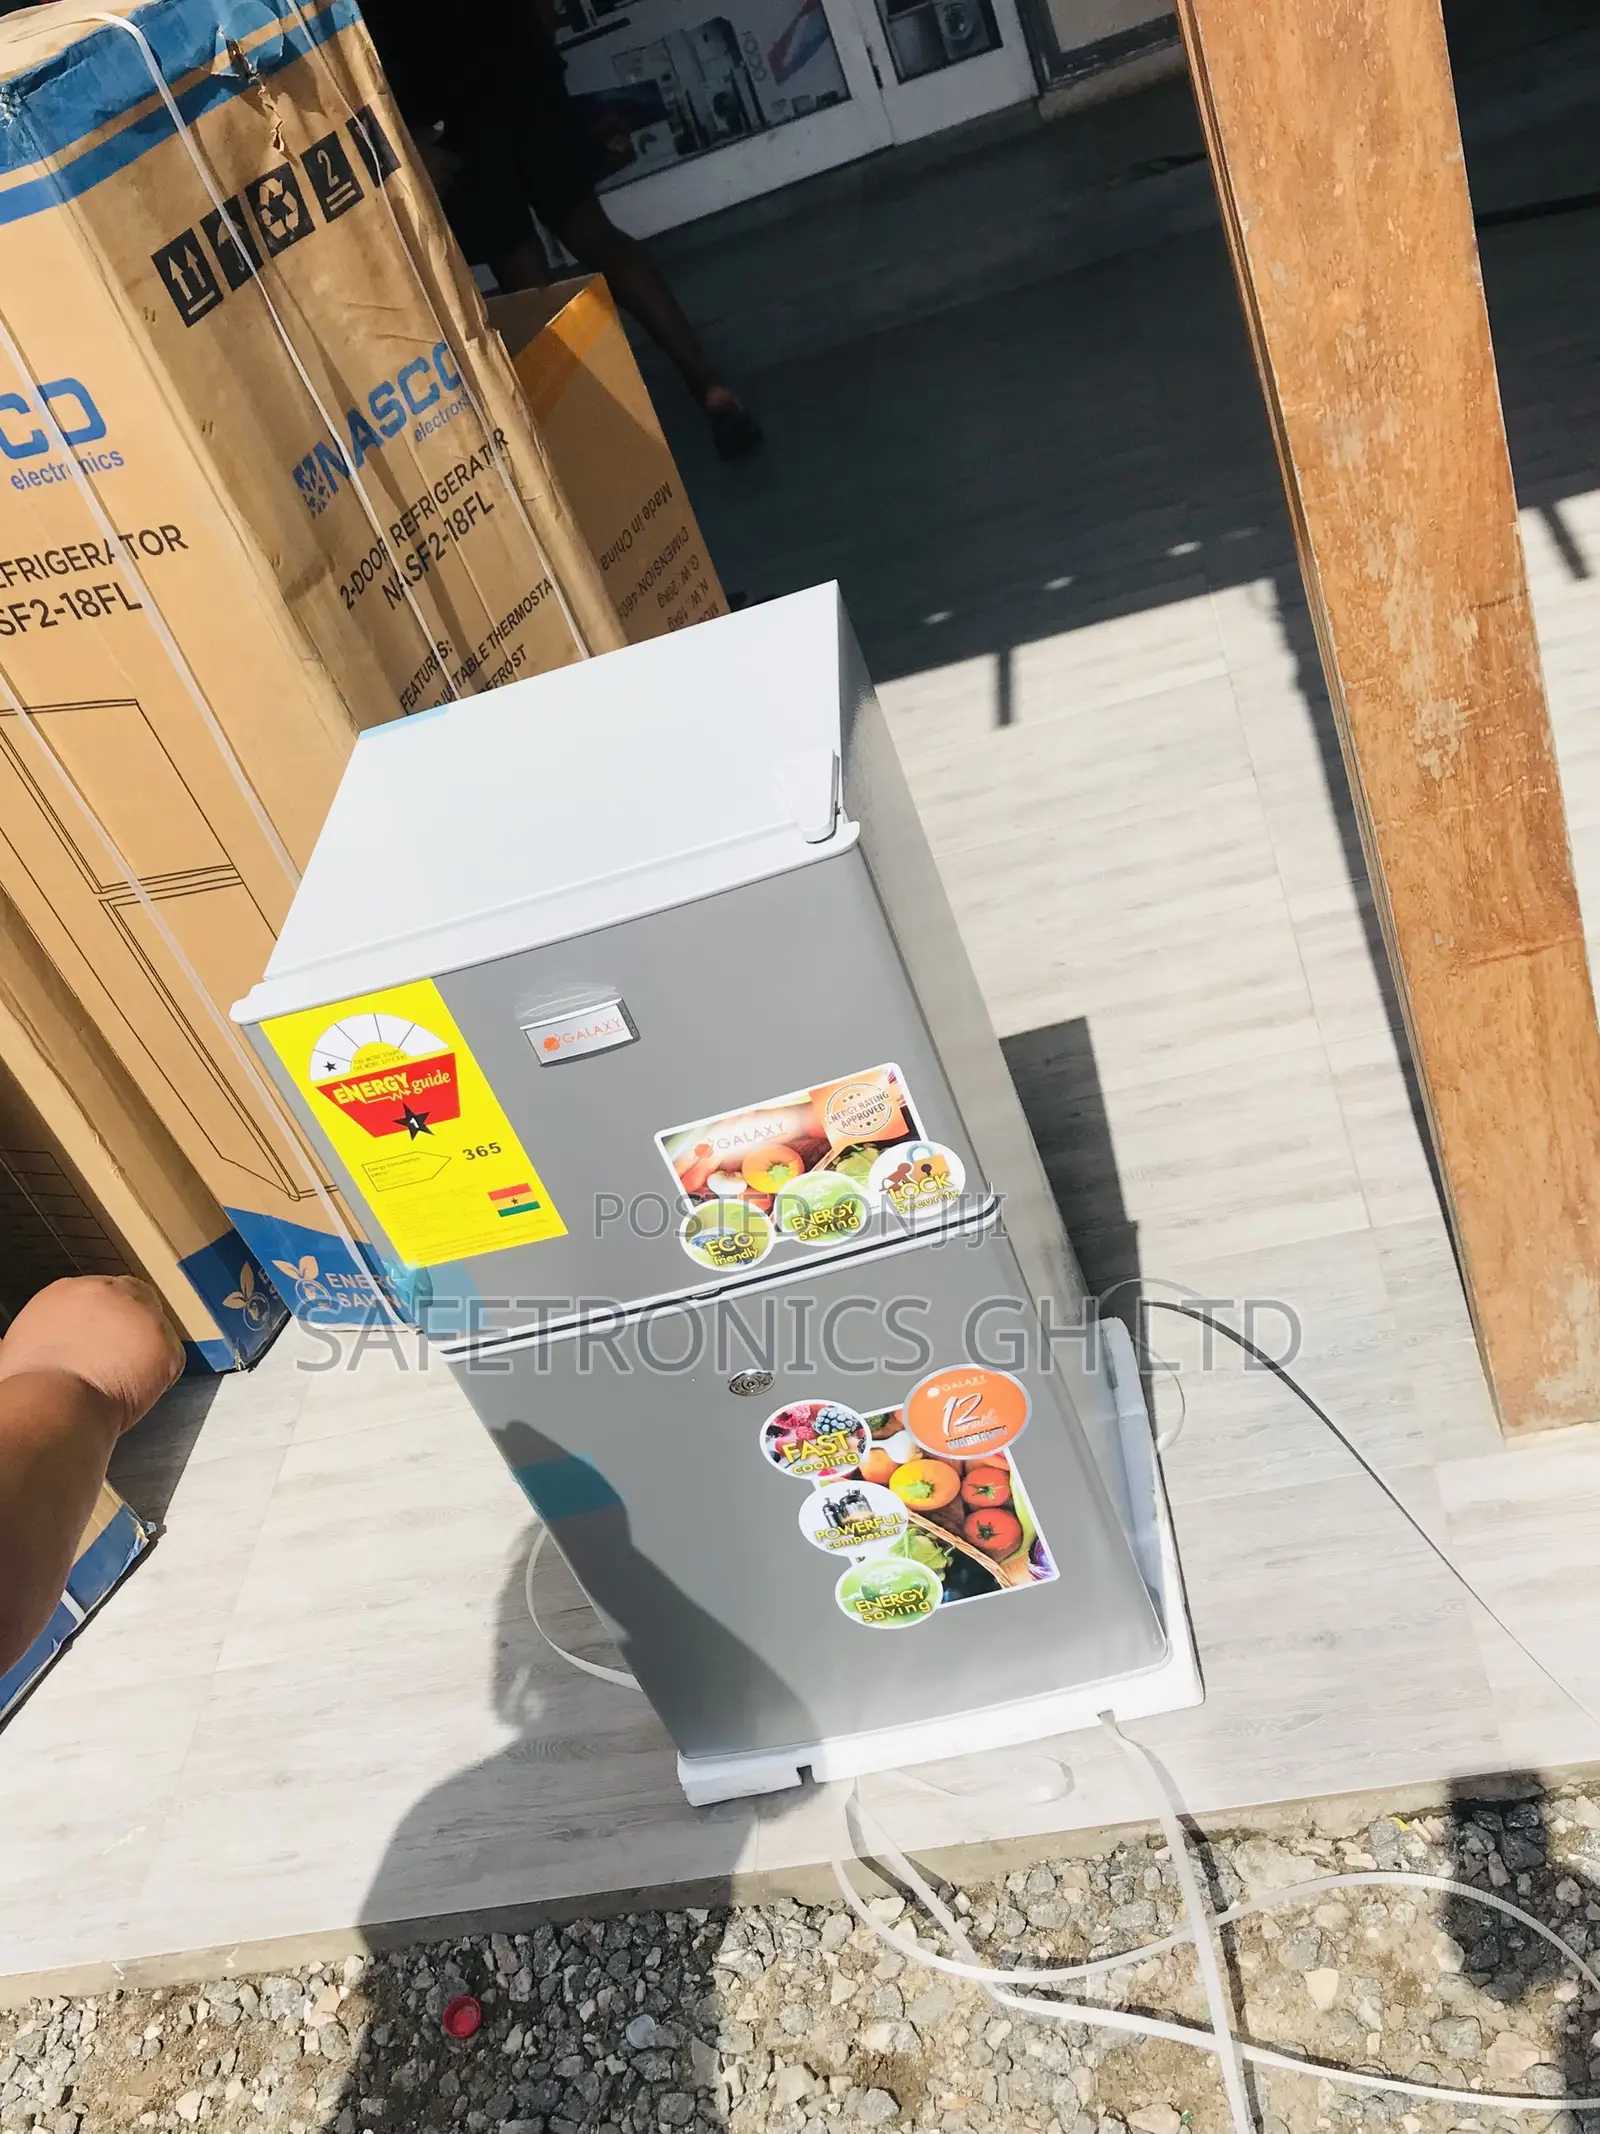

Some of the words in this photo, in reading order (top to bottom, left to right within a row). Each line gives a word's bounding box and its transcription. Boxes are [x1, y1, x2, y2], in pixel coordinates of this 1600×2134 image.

[10, 450, 125, 490] electrnics
[389, 427, 509, 548] REFRIGERATR
[642, 480, 674, 520] Made
[631, 513, 645, 532] in
[600, 528, 634, 571] China
[486, 577, 554, 650] THERMOSTA
[562, 1017, 621, 1043] GALAXY
[332, 1072, 409, 1105] ENERGY
[411, 1070, 452, 1095] guide
[858, 1090, 890, 1110] RATING
[409, 1116, 421, 1130] 1
[841, 1102, 886, 1129] APPROVED
[716, 1120, 786, 1150] GALAXY
[462, 1141, 502, 1161] 365
[888, 1170, 953, 1202] LOCK
[896, 1184, 960, 1214] Security
[790, 1200, 856, 1231] ENERGY
[798, 1214, 860, 1242] saving
[706, 1230, 754, 1257] ECO
[713, 1246, 760, 1267] friendly
[942, 1374, 986, 1391] GALAXY
[942, 1392, 982, 1437] 12
[782, 1429, 850, 1464] FAST
[793, 1452, 860, 1476] cooling
[815, 1512, 906, 1543] POWERFUL
[826, 1526, 902, 1550] compressor
[854, 1586, 928, 1614] ENERGY
[863, 1600, 932, 1624] saving
